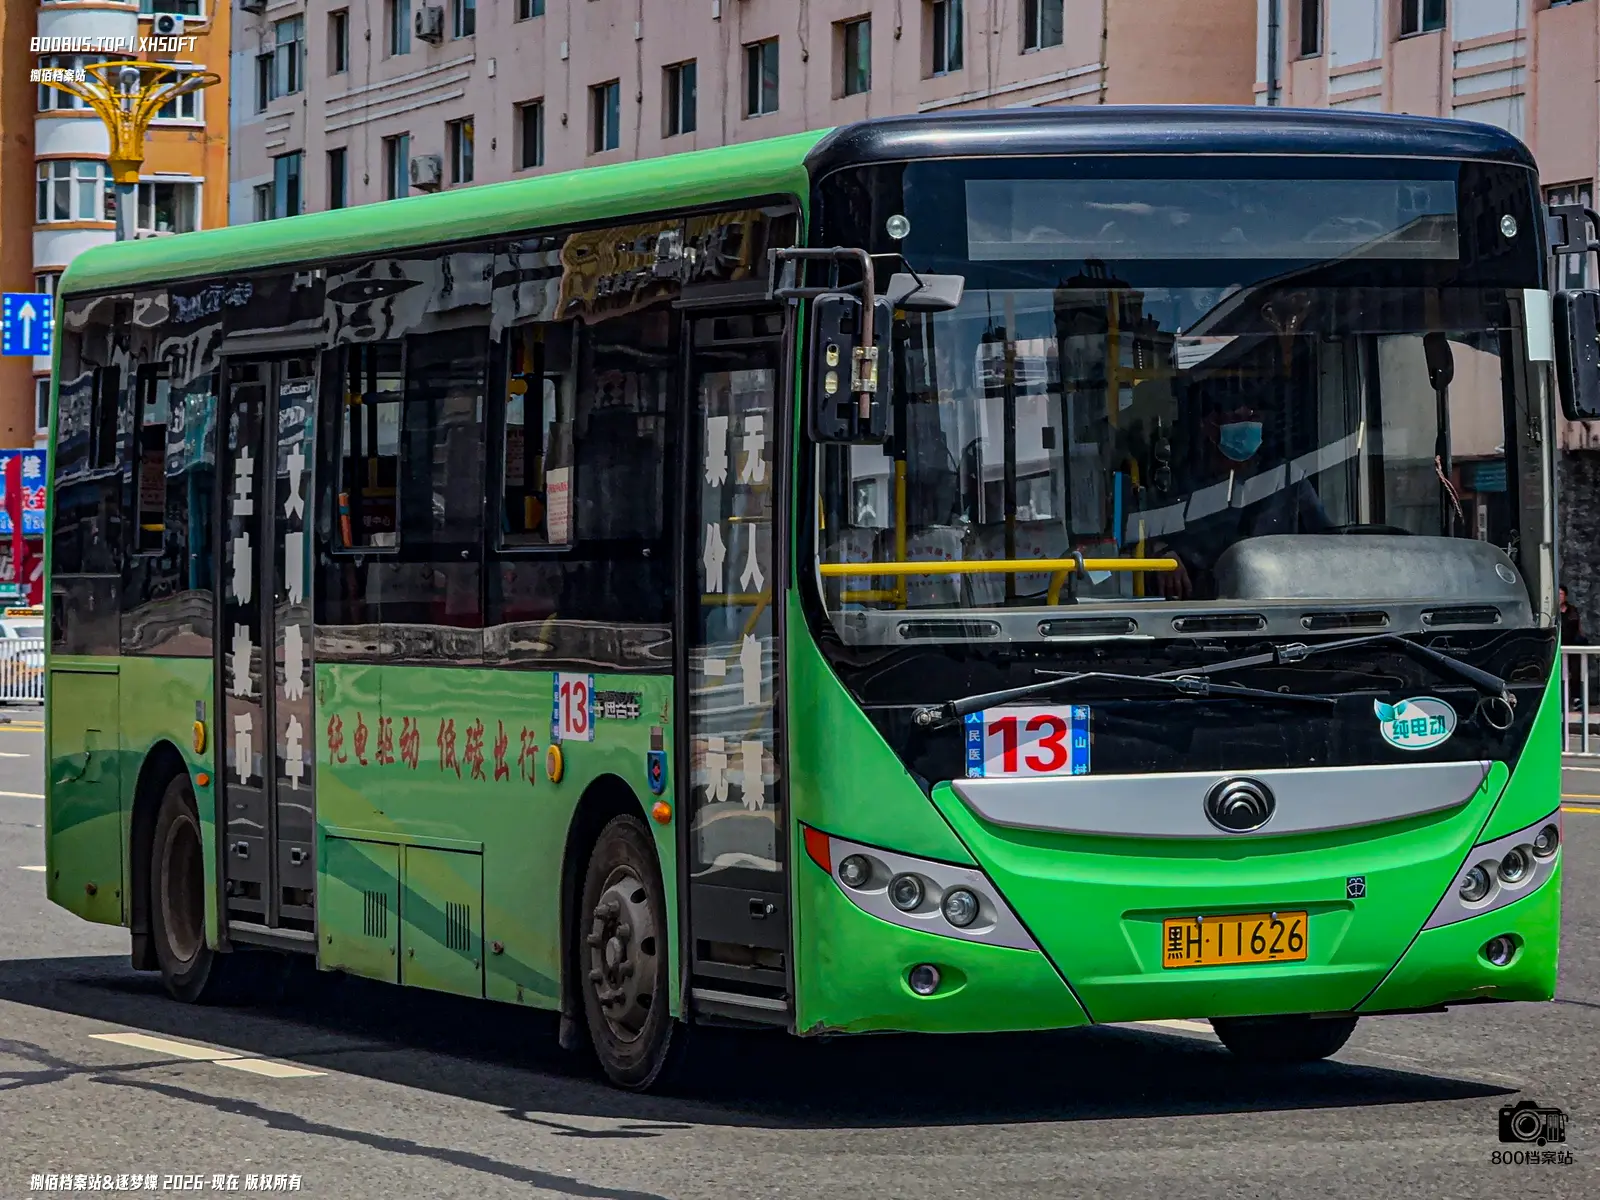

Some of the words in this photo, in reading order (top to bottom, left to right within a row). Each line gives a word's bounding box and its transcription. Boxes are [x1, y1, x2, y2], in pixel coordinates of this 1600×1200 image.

[560, 680, 588, 734] 13
[1391, 714, 1447, 740] 纯电动
[326, 711, 421, 771] 纯电驱动
[436, 716, 540, 787] 低碳出行
[967, 712, 982, 778] 人民医院
[987, 714, 1068, 773] 13
